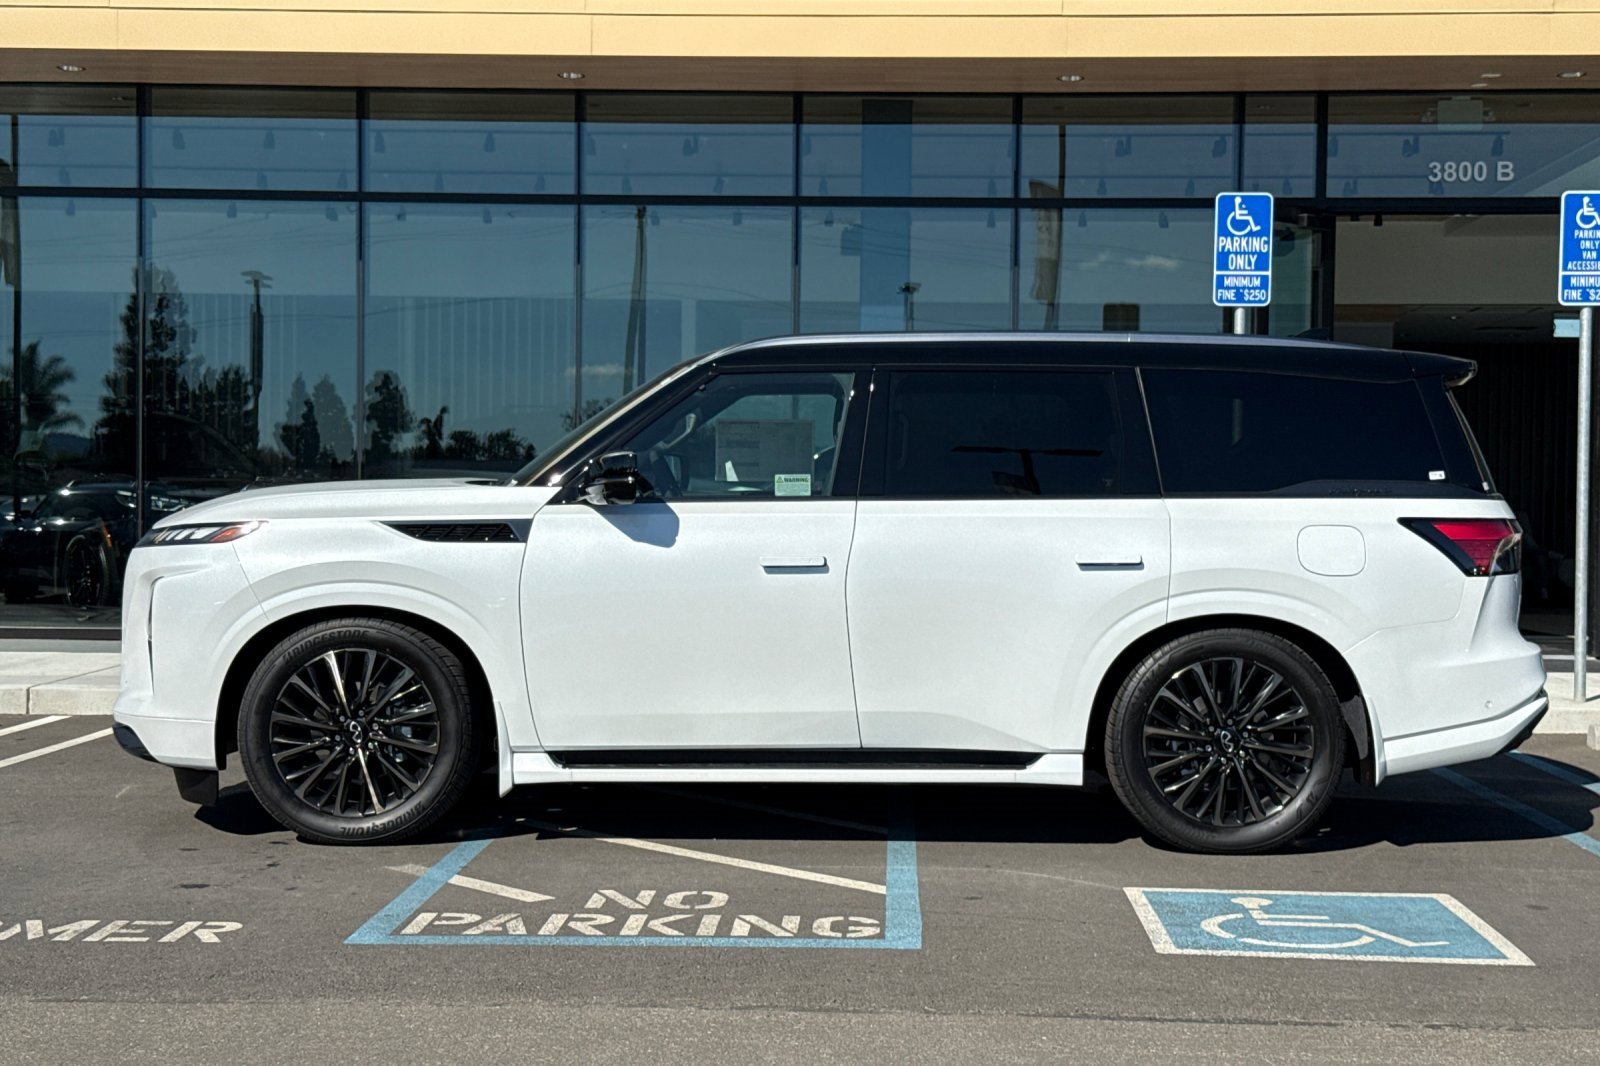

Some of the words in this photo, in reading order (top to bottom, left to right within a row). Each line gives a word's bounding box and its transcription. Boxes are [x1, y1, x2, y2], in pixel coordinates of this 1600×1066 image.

[1428, 161, 1487, 182] 3800
[1497, 161, 1514, 181] B
[1218, 236, 1268, 253] PARKING
[1580, 240, 1600, 250] ONLY
[1228, 254, 1257, 270] ONLY
[1582, 250, 1597, 260] VAN
[1223, 276, 1261, 288] MINIMUM
[1217, 289, 1236, 300] FINE
[1243, 289, 1266, 301] $250
[1563, 289, 1583, 301] FINE
[283, 629, 370, 660] BRIDGESTONE
[584, 889, 729, 910] NO
[400, 912, 881, 938] PARKING
